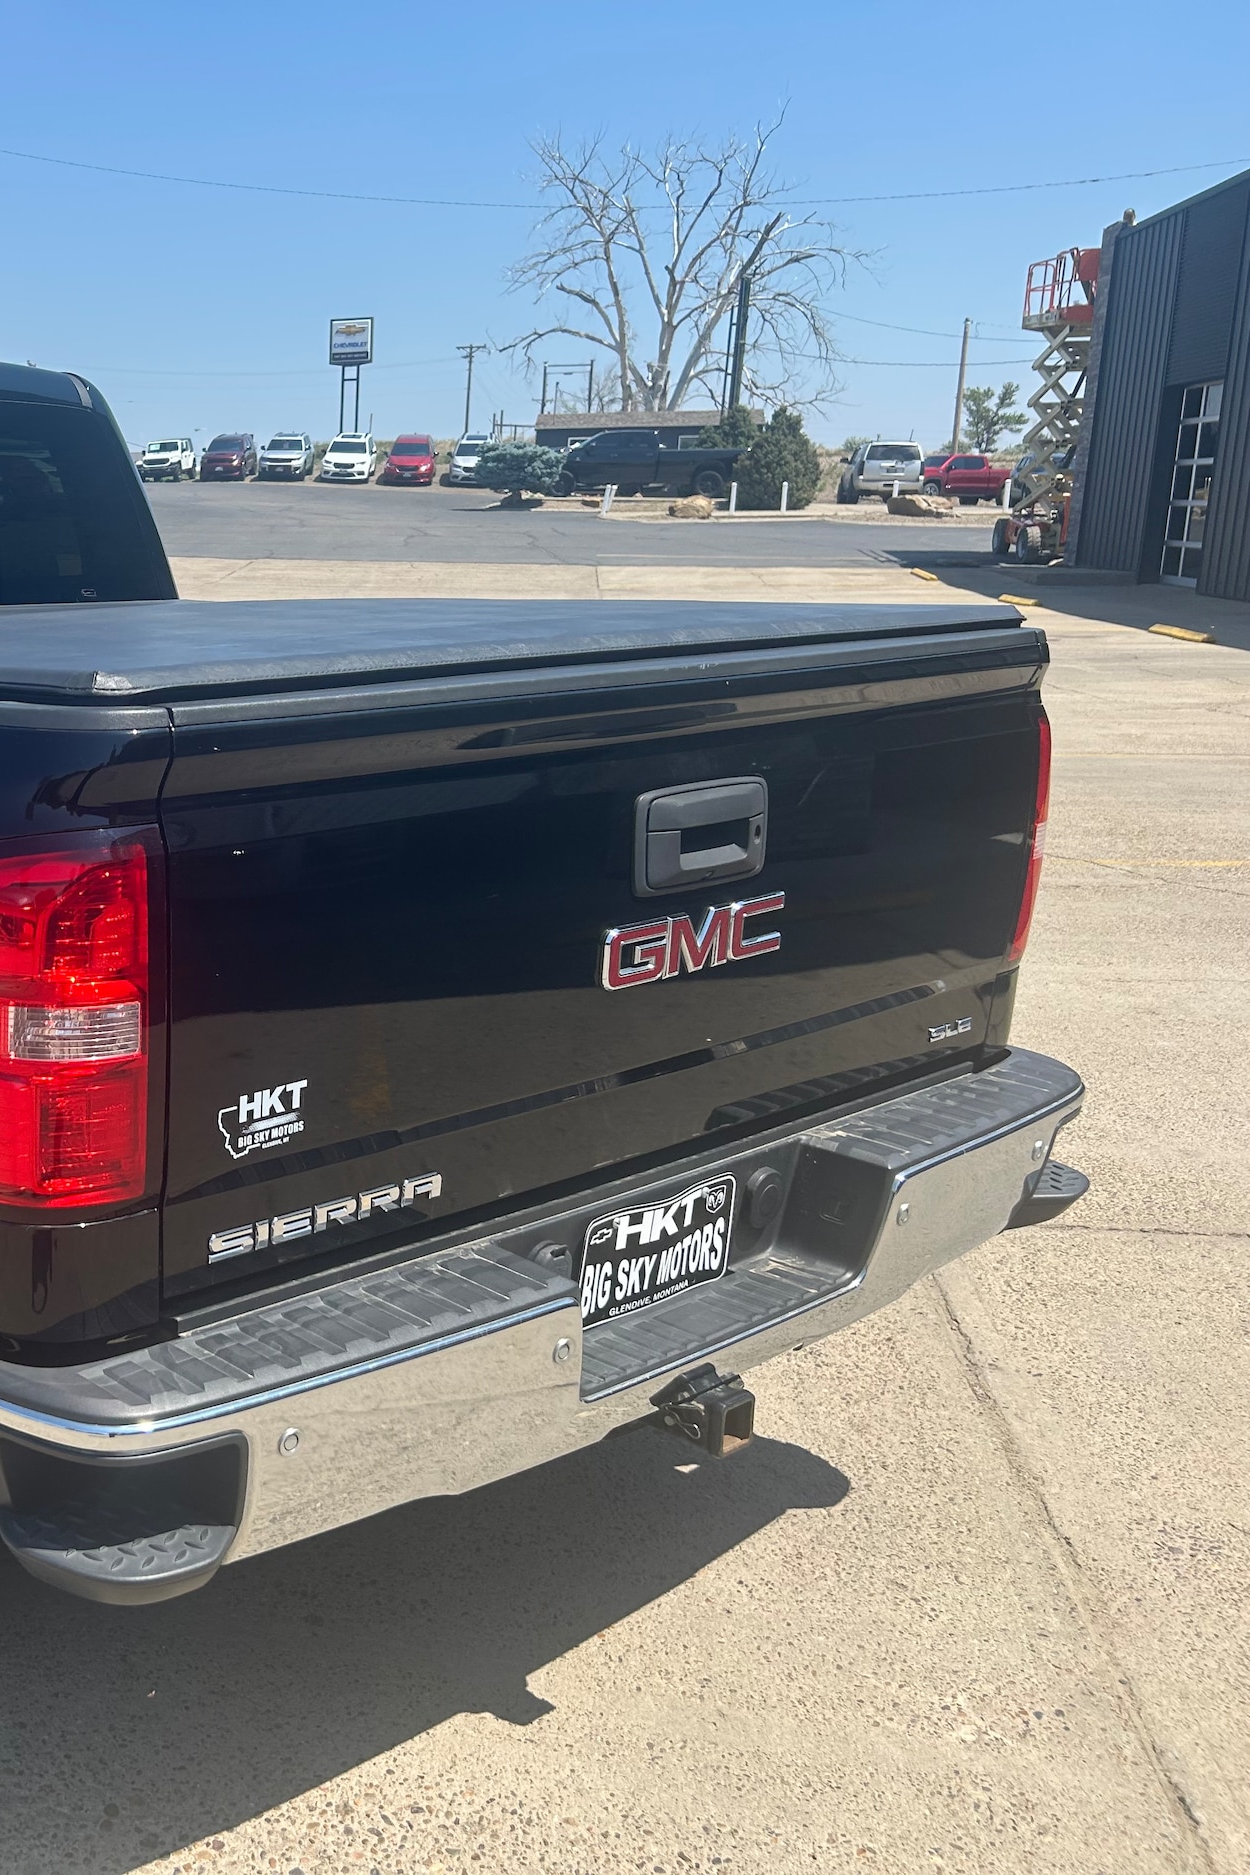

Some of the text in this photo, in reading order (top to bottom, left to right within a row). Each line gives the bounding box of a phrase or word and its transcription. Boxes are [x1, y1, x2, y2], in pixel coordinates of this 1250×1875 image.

[599, 890, 786, 992] GMC
[927, 1016, 972, 1043] SLE
[239, 1079, 308, 1123] HKT
[238, 1120, 304, 1148] BIG SKY MOTORS
[207, 1171, 443, 1265] SIERRA
[615, 1190, 703, 1251] HKT
[581, 1216, 725, 1319] BIG SKY MOTORS
[609, 1279, 689, 1317] GLENDIVE, MONTANA
